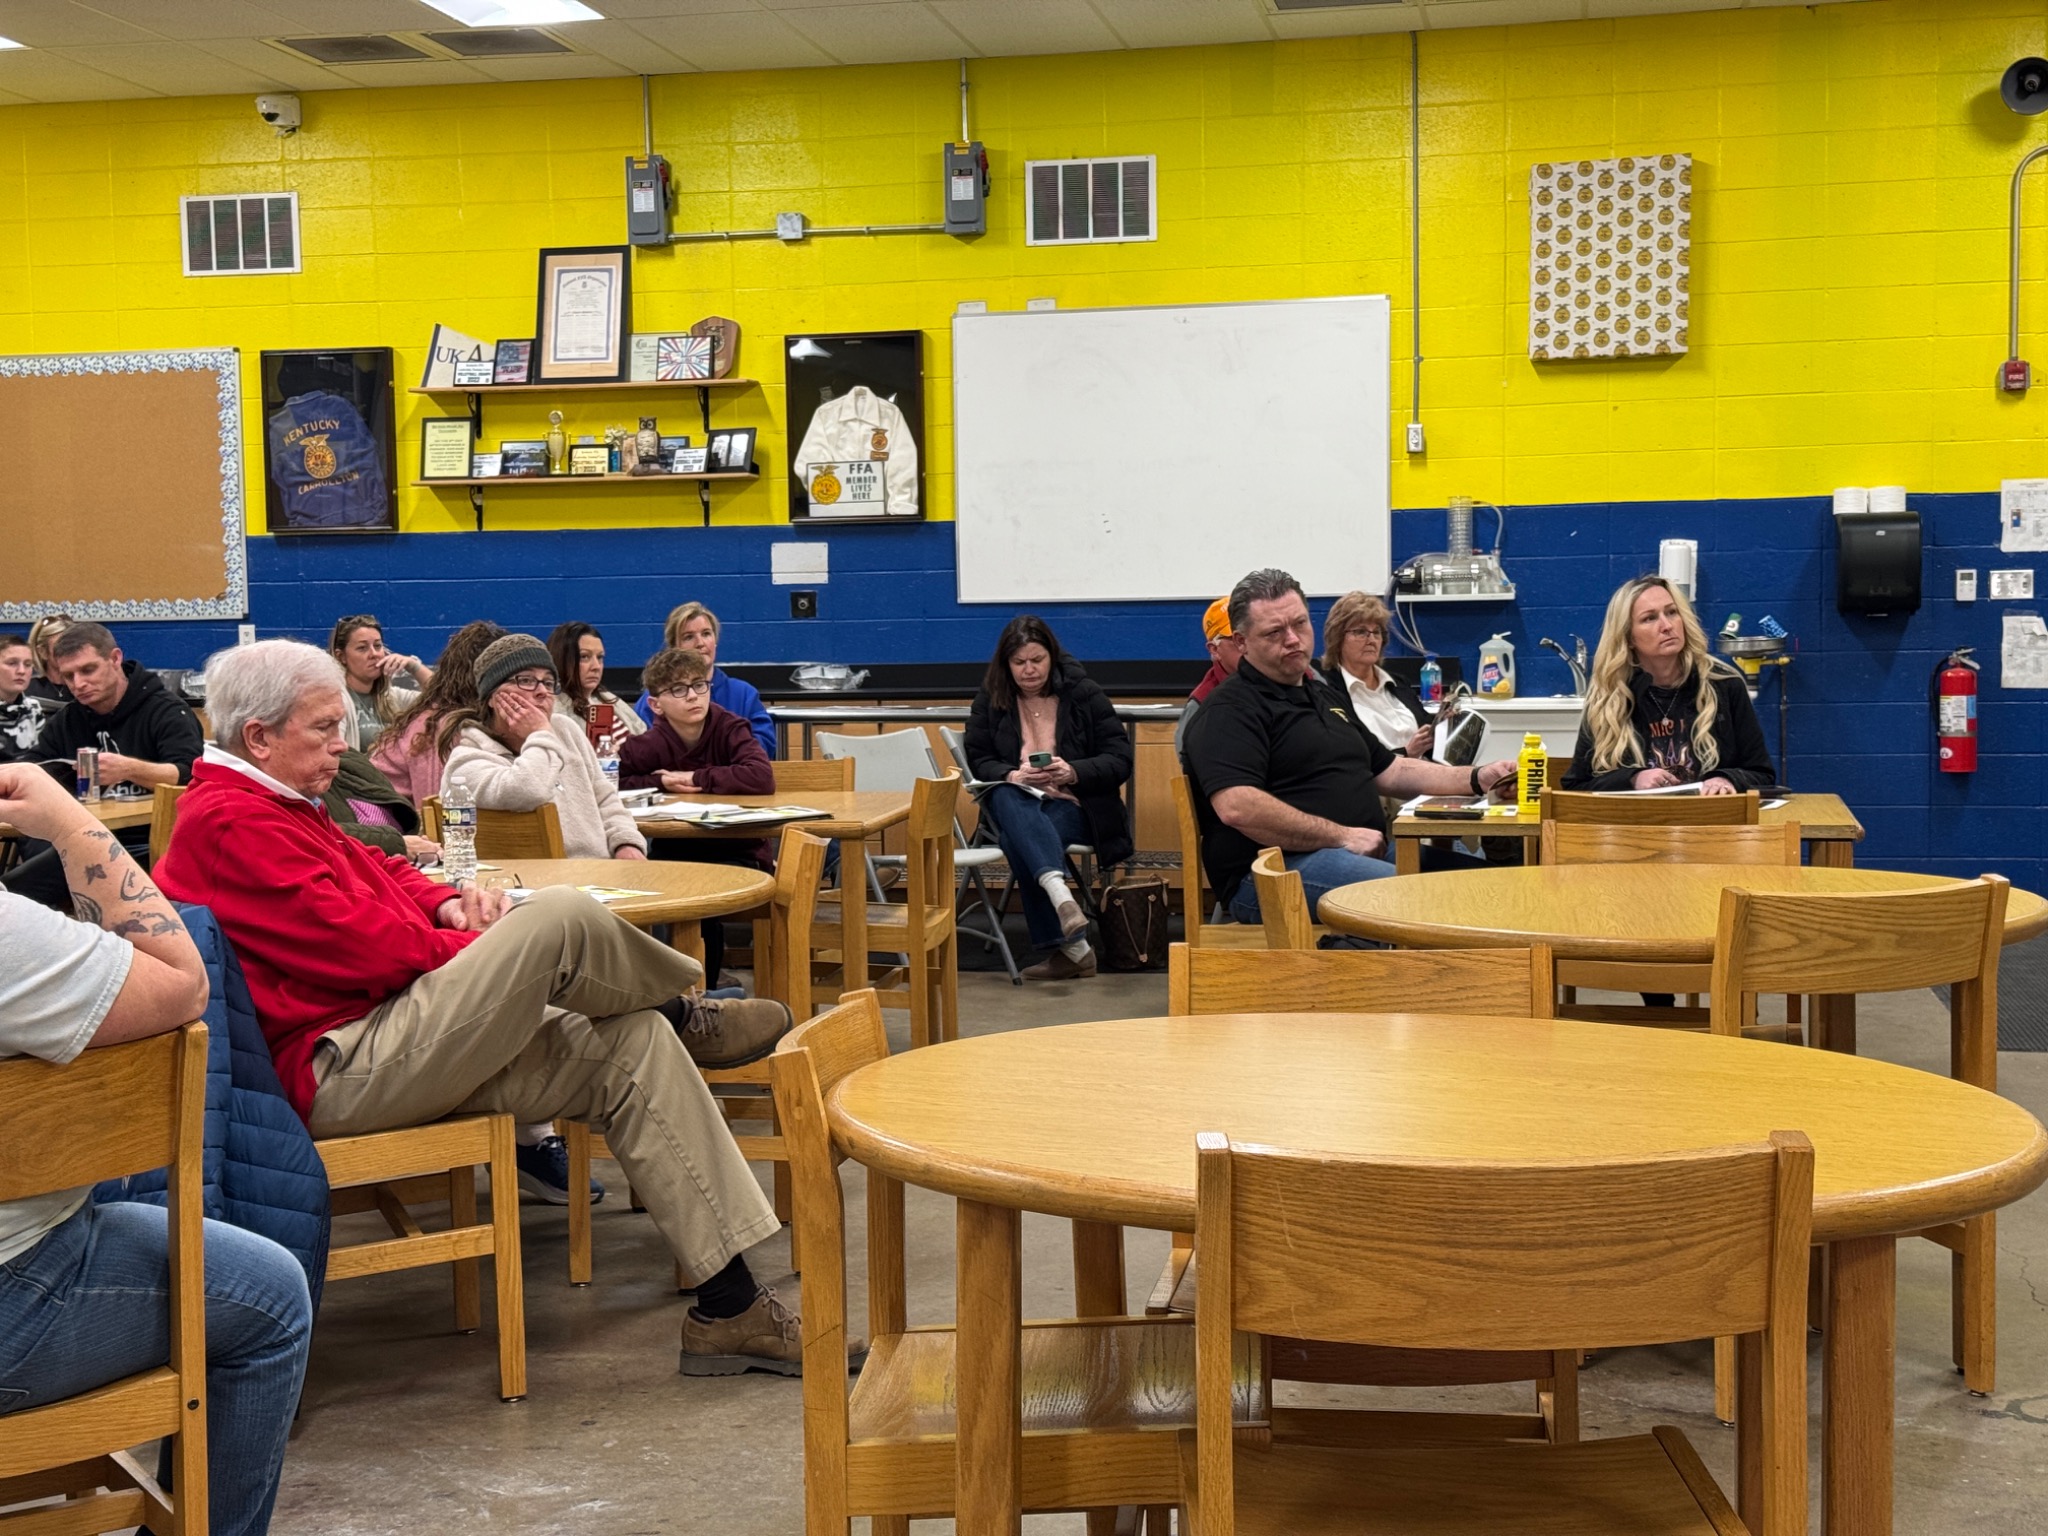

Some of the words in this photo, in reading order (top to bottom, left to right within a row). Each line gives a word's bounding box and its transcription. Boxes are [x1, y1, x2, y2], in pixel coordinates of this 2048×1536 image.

[436, 346, 465, 364] UK
[283, 419, 340, 447] KENTUCKY
[849, 463, 873, 475] FFA
[845, 476, 877, 485] MEMBER
[850, 484, 872, 493] LIVES
[852, 492, 871, 500] HERE
[1526, 758, 1545, 803] PRIME
